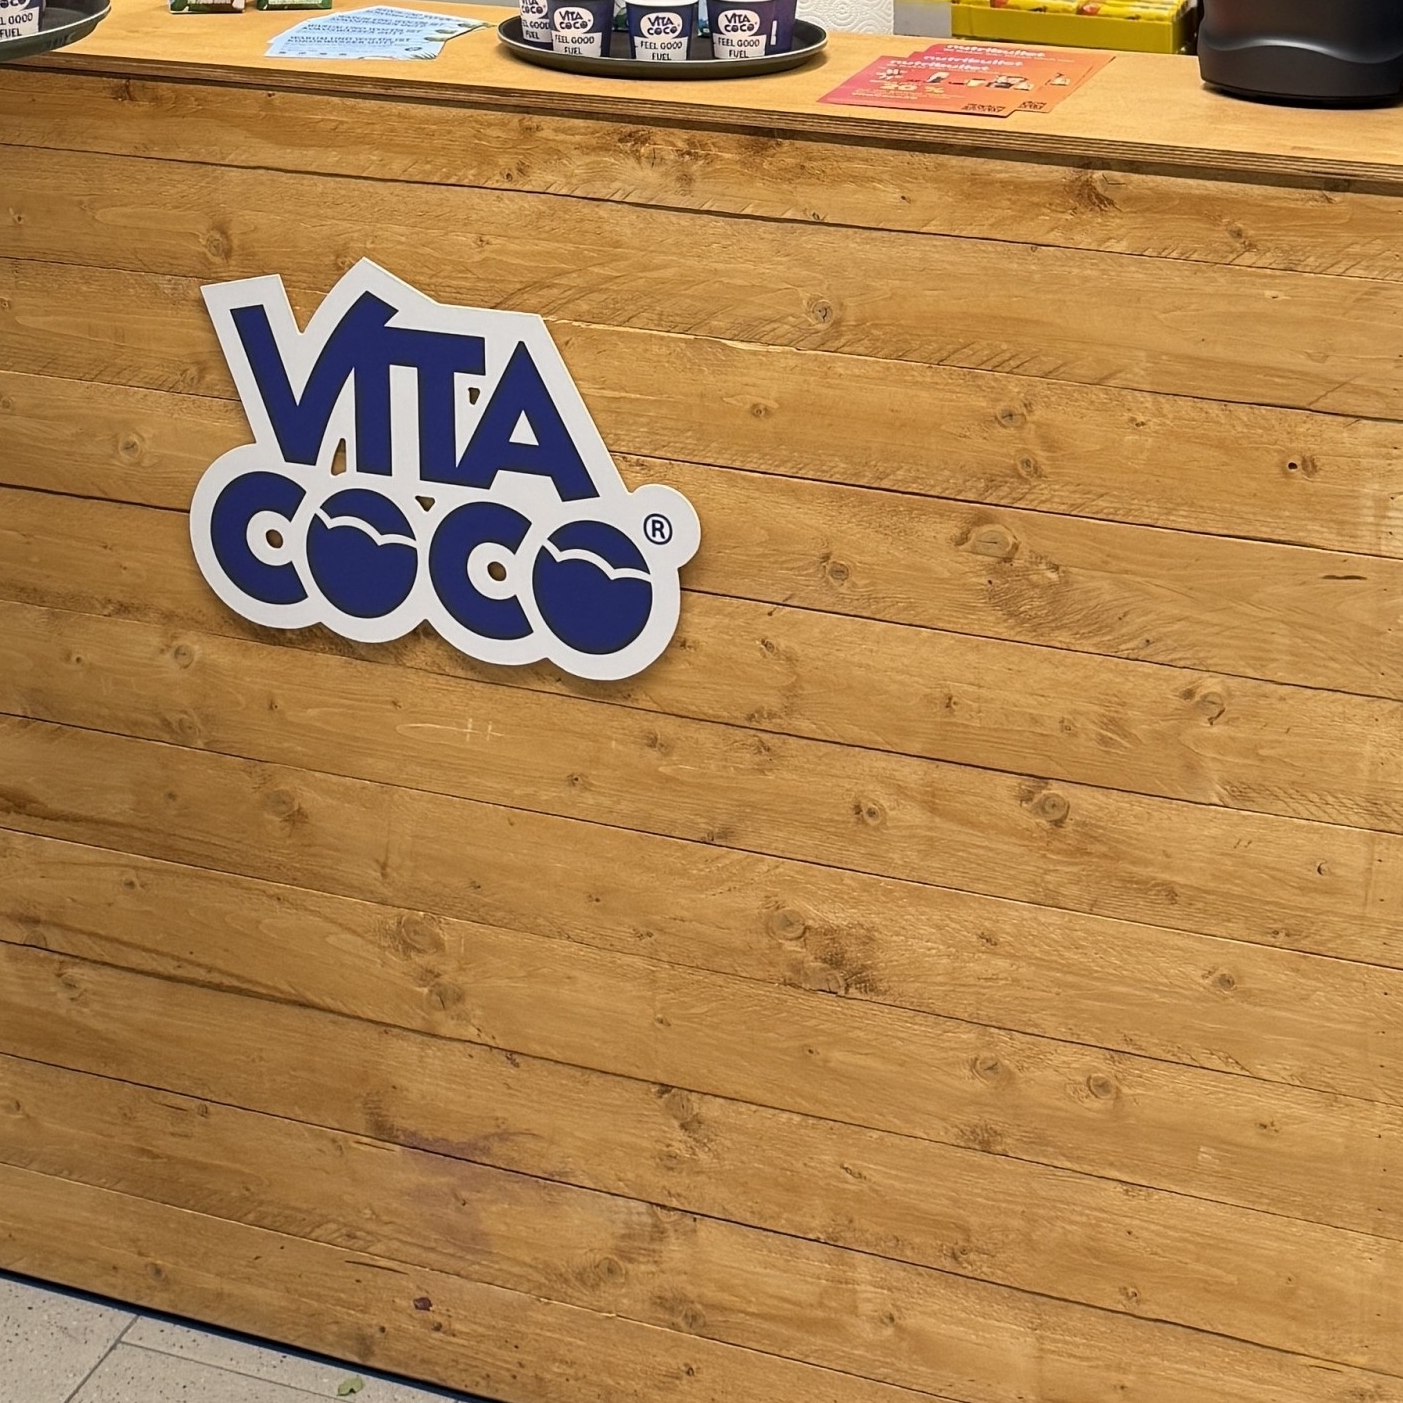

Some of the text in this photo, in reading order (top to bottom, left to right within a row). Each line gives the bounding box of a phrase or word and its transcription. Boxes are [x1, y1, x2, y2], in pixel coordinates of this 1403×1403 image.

[521, 6, 544, 14] COCO
[8, 12, 33, 24] GOOD
[559, 10, 583, 21] VITA
[725, 13, 748, 23] VITA
[559, 21, 588, 29] COCO
[648, 15, 674, 26] VITA
[647, 26, 678, 35] COCO
[724, 23, 754, 32] COCO
[0, 29, 22, 38] FUEL
[525, 30, 539, 39] FUEL
[555, 34, 595, 44] FEEL GOOD
[718, 38, 760, 47] FEEL GOOD
[640, 40, 682, 49] FEEL GOOD
[564, 47, 582, 55] FUEL
[729, 50, 749, 58] FUEL
[230, 290, 601, 502] VITA
[210, 471, 654, 656] COCO
